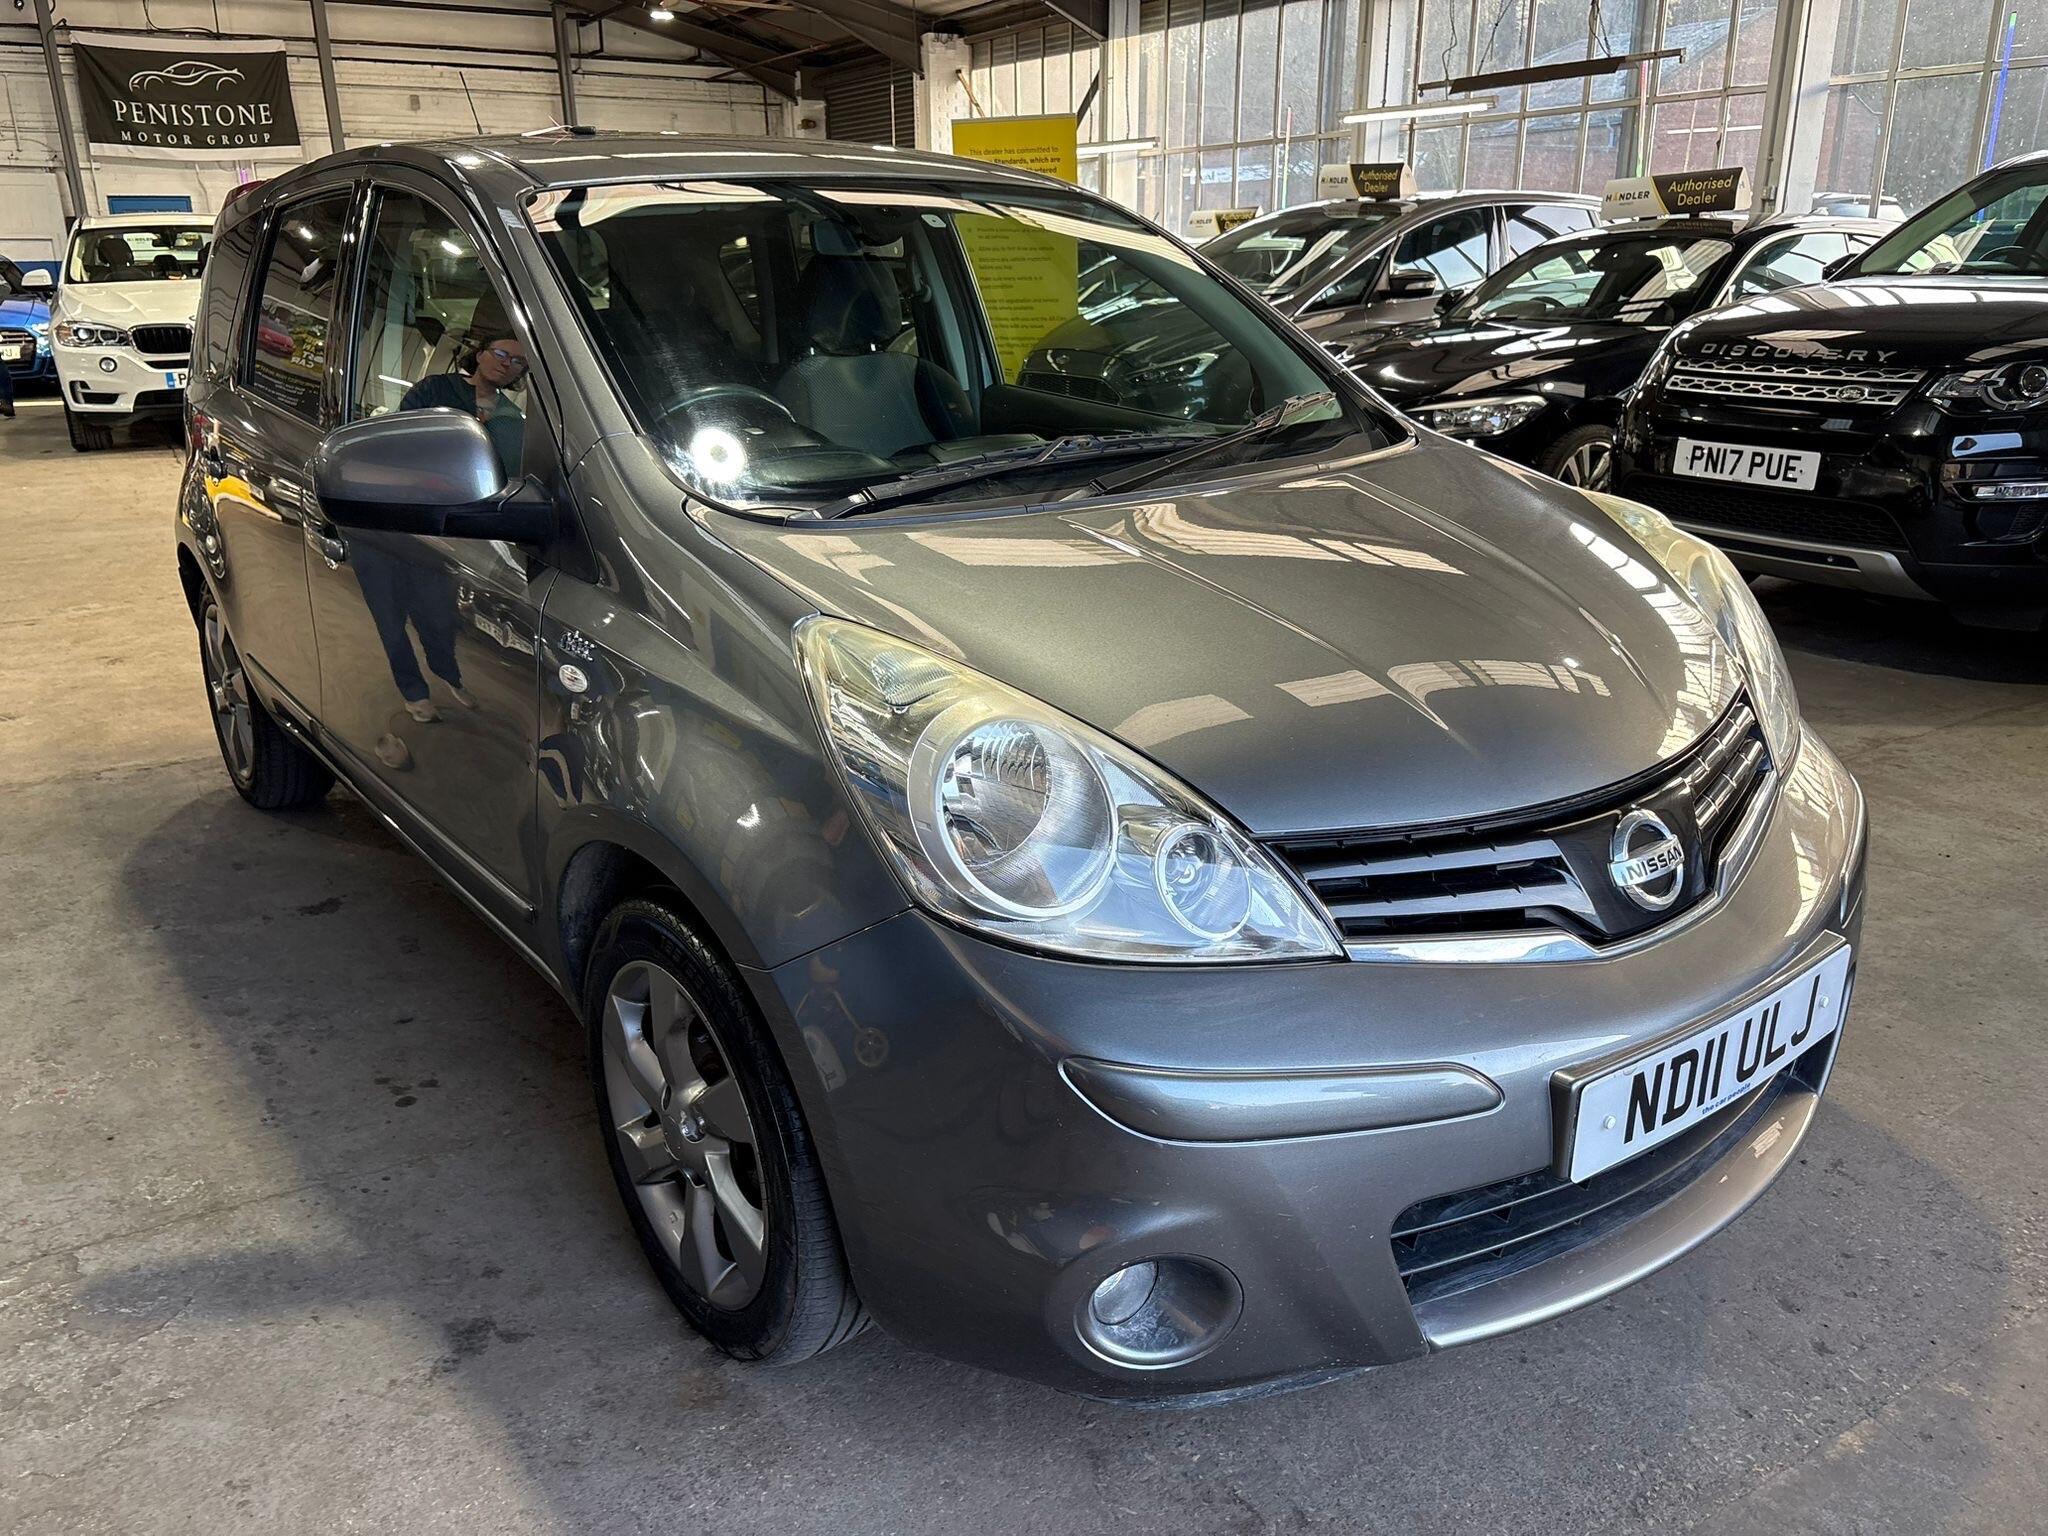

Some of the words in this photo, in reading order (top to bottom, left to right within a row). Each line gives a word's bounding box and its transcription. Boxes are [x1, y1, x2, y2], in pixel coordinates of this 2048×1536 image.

[112, 99, 273, 127] PENISTONE
[121, 130, 192, 145] MOTOR
[207, 133, 272, 146] GROUP
[1359, 169, 1398, 181] Authorised
[1668, 175, 1733, 193] Authorised
[1364, 182, 1389, 193] Dealer
[1677, 193, 1718, 206] Dealer
[1700, 343, 1898, 364] DISCOVERY
[1688, 445, 1744, 476] PN17
[1748, 451, 1802, 483] PUE
[1625, 846, 1683, 881] NISSAN
[1623, 1031, 1729, 1145] ND11
[1736, 974, 1821, 1083] ULJ
[1701, 1104, 1715, 1115] the
[1715, 1096, 1727, 1107] car
[1727, 1082, 1751, 1101] people
